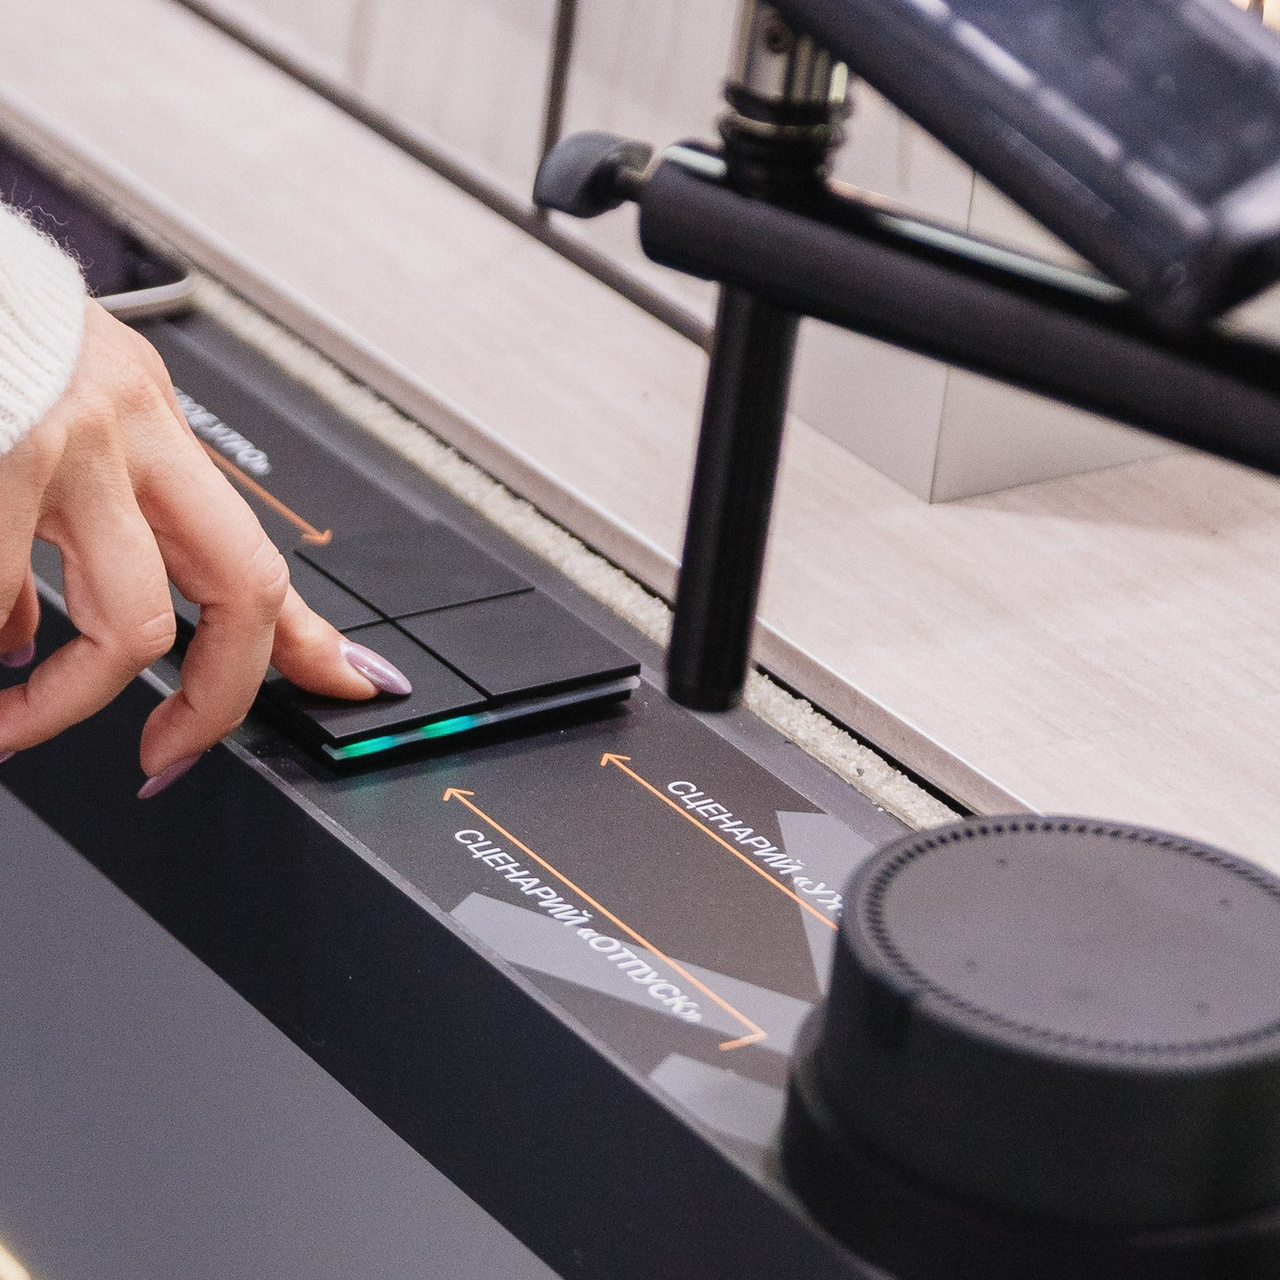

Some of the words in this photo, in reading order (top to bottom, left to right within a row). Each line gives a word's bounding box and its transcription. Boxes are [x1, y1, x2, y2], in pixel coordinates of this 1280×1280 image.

[667, 779, 804, 876] СЦЕНАРИЙ
[454, 828, 594, 928] СЦЕНАРИЙ
[576, 926, 703, 1024] «ОТПУСК»
